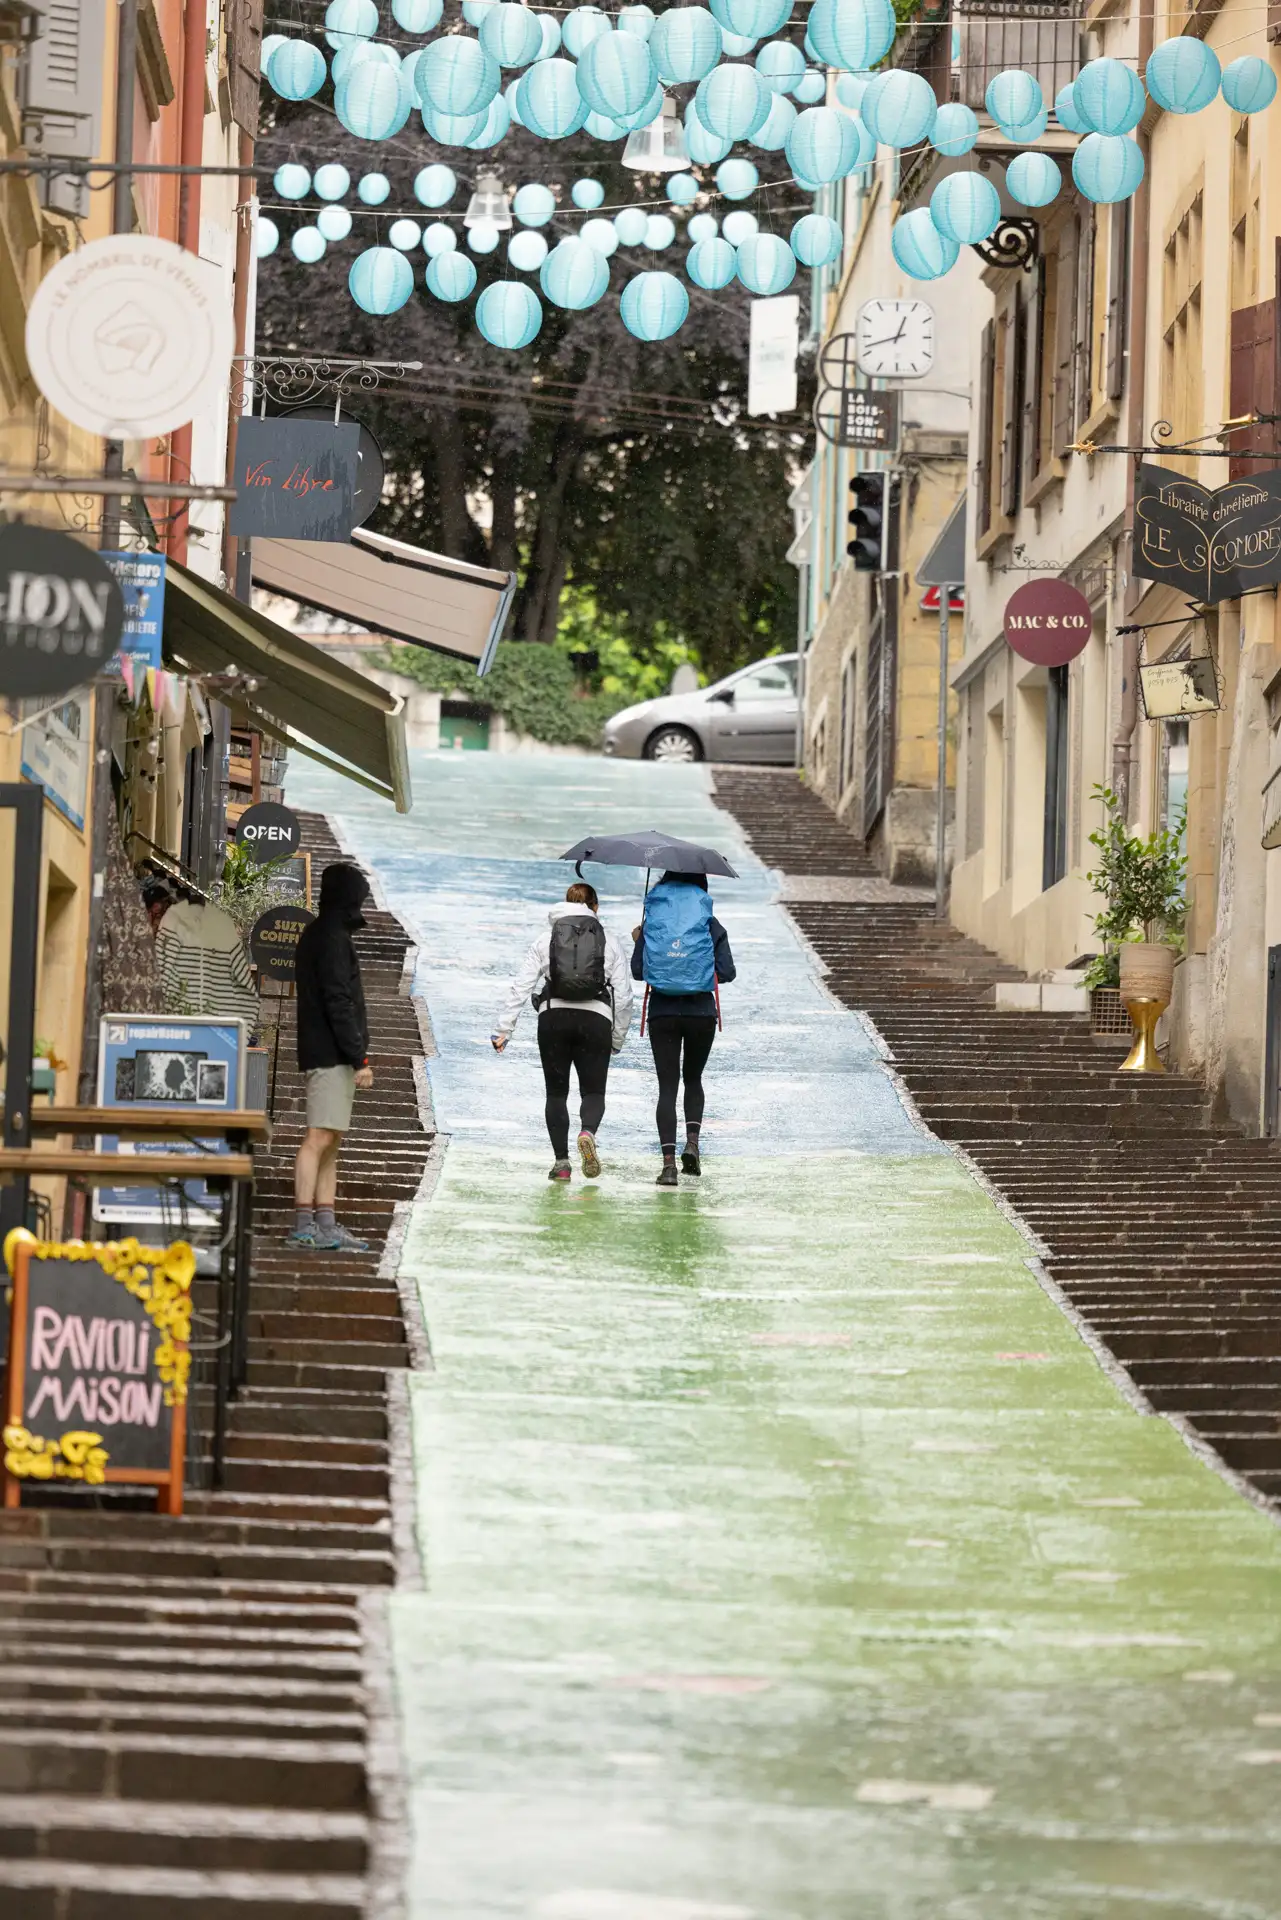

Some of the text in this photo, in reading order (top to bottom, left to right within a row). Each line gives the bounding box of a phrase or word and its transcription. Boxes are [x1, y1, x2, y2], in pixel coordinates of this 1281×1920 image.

[141, 253, 163, 271] DE
[848, 392, 866, 404] LA
[846, 425, 886, 439] NERIE
[245, 460, 274, 487] Vin
[1158, 487, 1269, 522] Librairie chrétienne
[1143, 522, 1172, 553] LE
[1008, 615, 1089, 629] MAC & CO.
[243, 825, 292, 841] OPEN
[274, 919, 306, 933] SUZY
